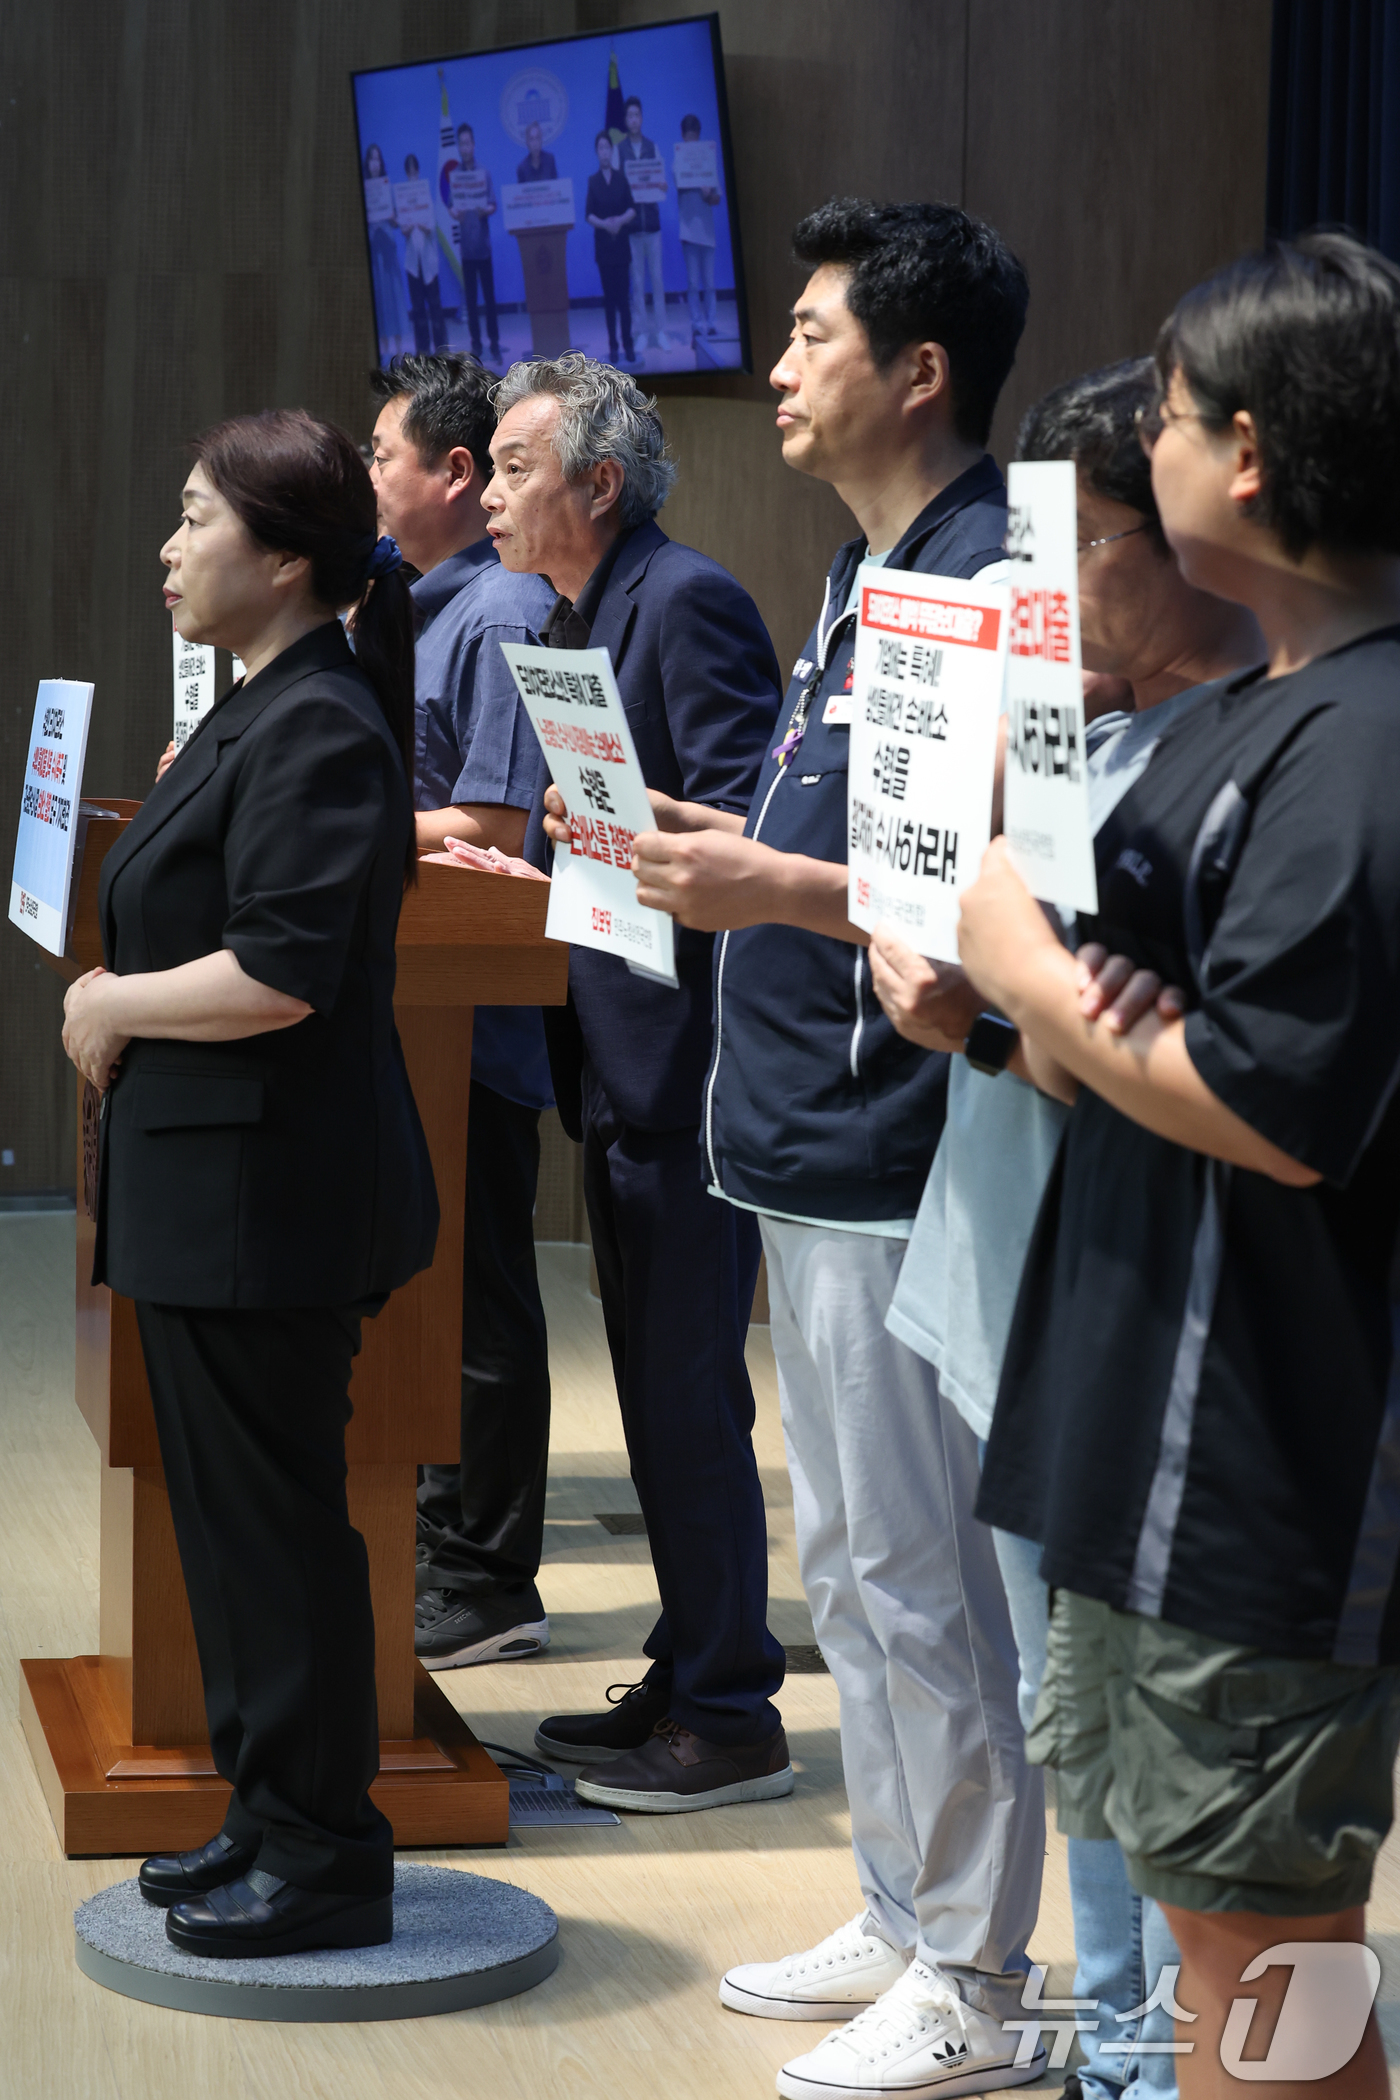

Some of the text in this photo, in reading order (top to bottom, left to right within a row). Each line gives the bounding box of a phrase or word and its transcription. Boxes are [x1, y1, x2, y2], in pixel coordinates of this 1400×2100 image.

[910, 645, 944, 687] 특혜
[905, 696, 949, 741] 손배소
[578, 766, 616, 815] 수협은
[872, 740, 911, 801] 수협을
[569, 811, 613, 866] 손배소를
[876, 811, 959, 885] 수사하라!
[591, 907, 612, 936] 진보당
